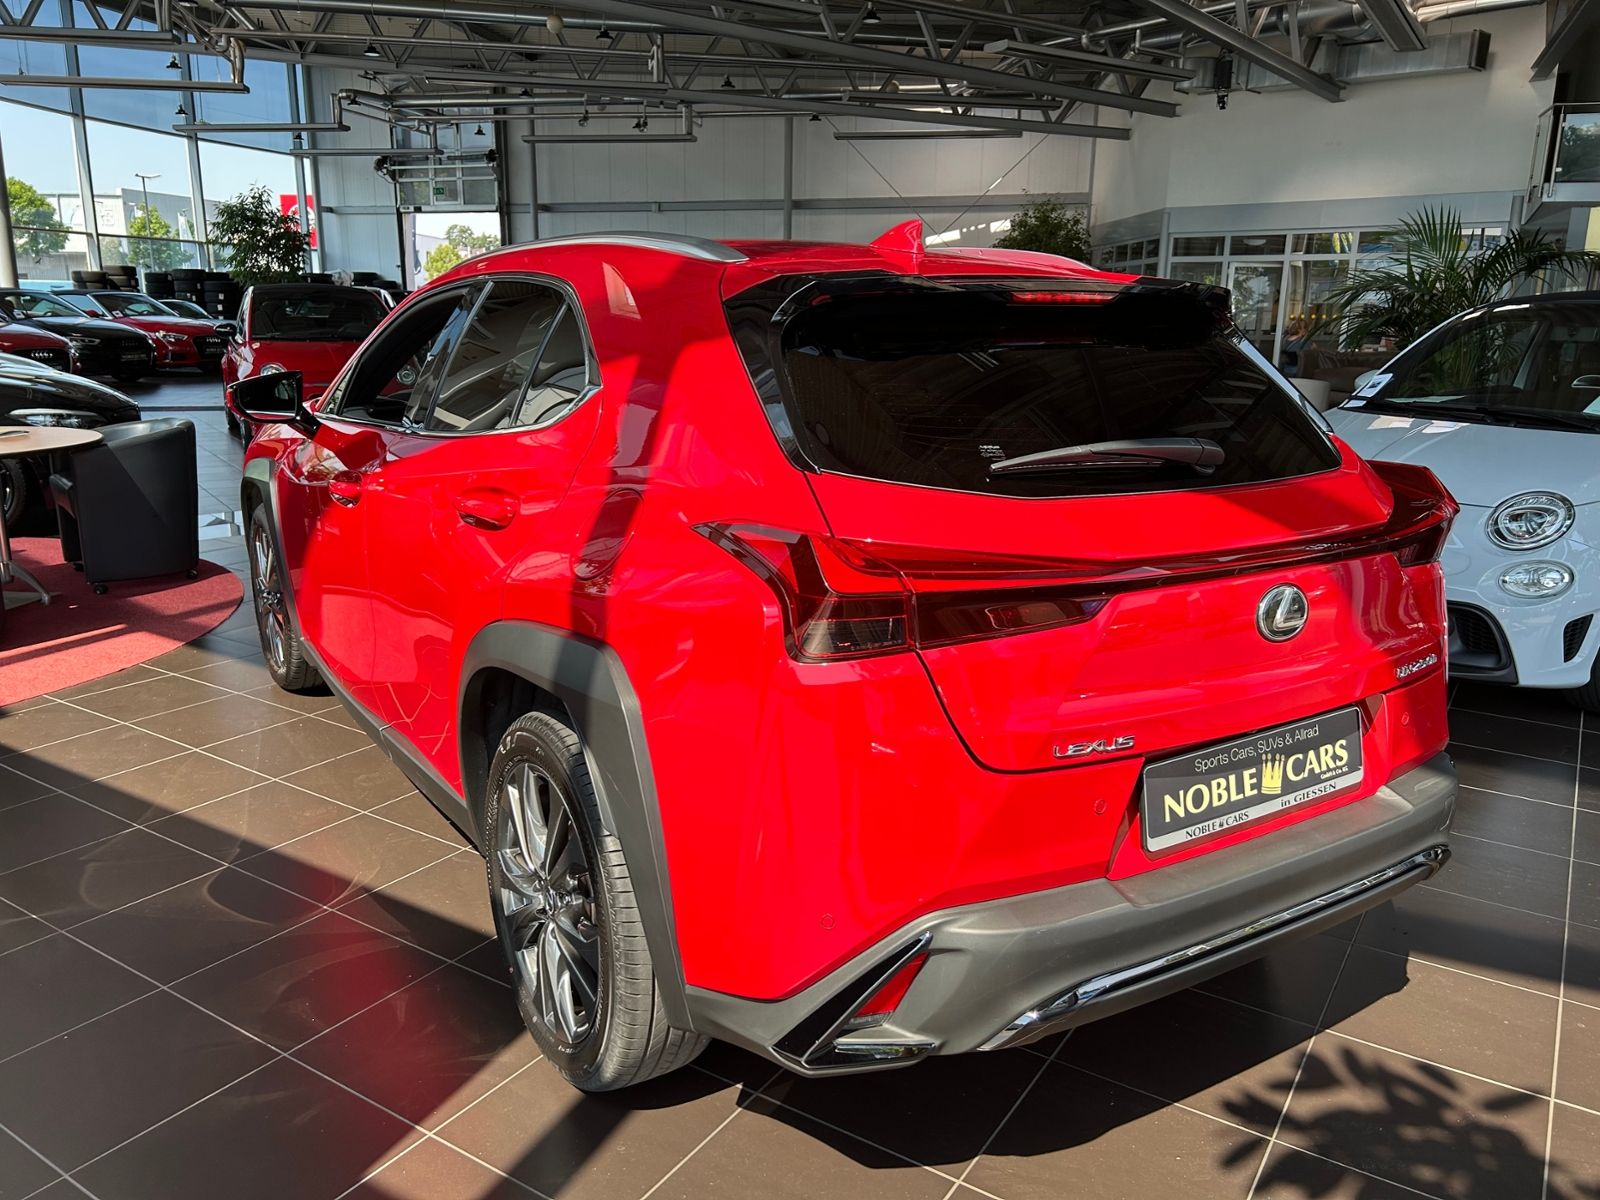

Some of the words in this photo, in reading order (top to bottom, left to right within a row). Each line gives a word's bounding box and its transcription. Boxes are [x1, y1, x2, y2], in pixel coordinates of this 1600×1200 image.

[1053, 735, 1135, 757] LEXUS
[1195, 753, 1229, 772] Sports
[1230, 745, 1257, 762] Cars,
[1257, 735, 1284, 754] SUVs
[1285, 732, 1293, 745] &
[1294, 725, 1319, 742] Allrad
[1163, 767, 1258, 823] NOBLE
[1286, 739, 1349, 782] CARS
[1280, 798, 1291, 808] in
[1294, 781, 1337, 804] GIESSEN
[1185, 821, 1217, 839] NOBLE
[1225, 811, 1250, 827] CARS
